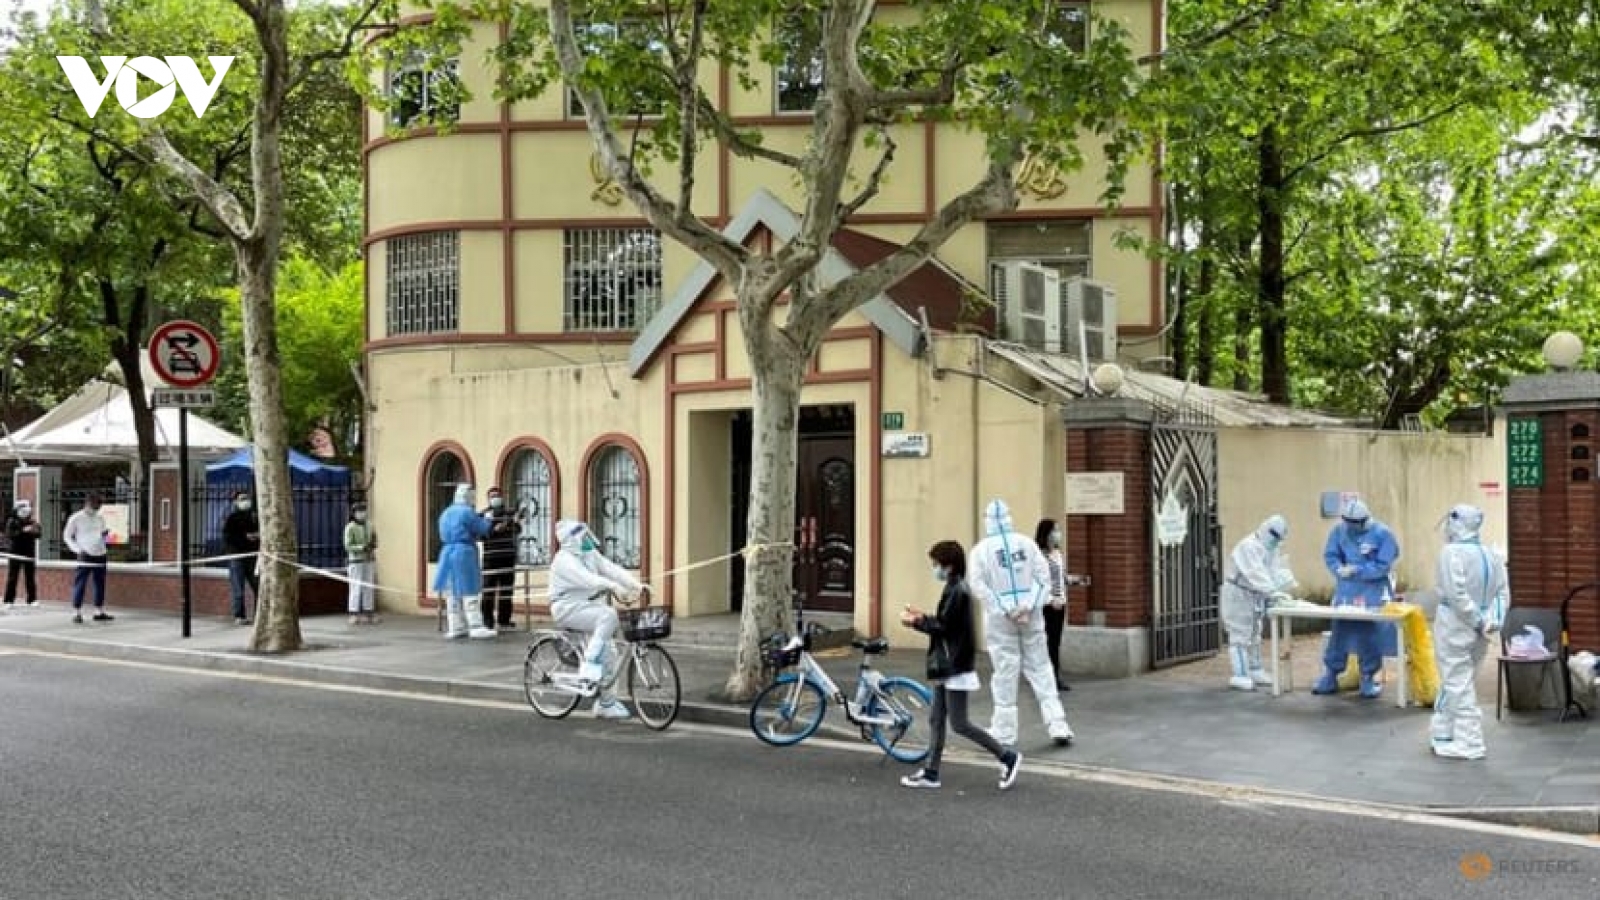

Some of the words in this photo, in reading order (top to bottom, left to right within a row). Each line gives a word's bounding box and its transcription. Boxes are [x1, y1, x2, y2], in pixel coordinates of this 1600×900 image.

[1510, 421, 1537, 434] 270
[1510, 444, 1538, 455] 272
[1510, 466, 1539, 478] 274
